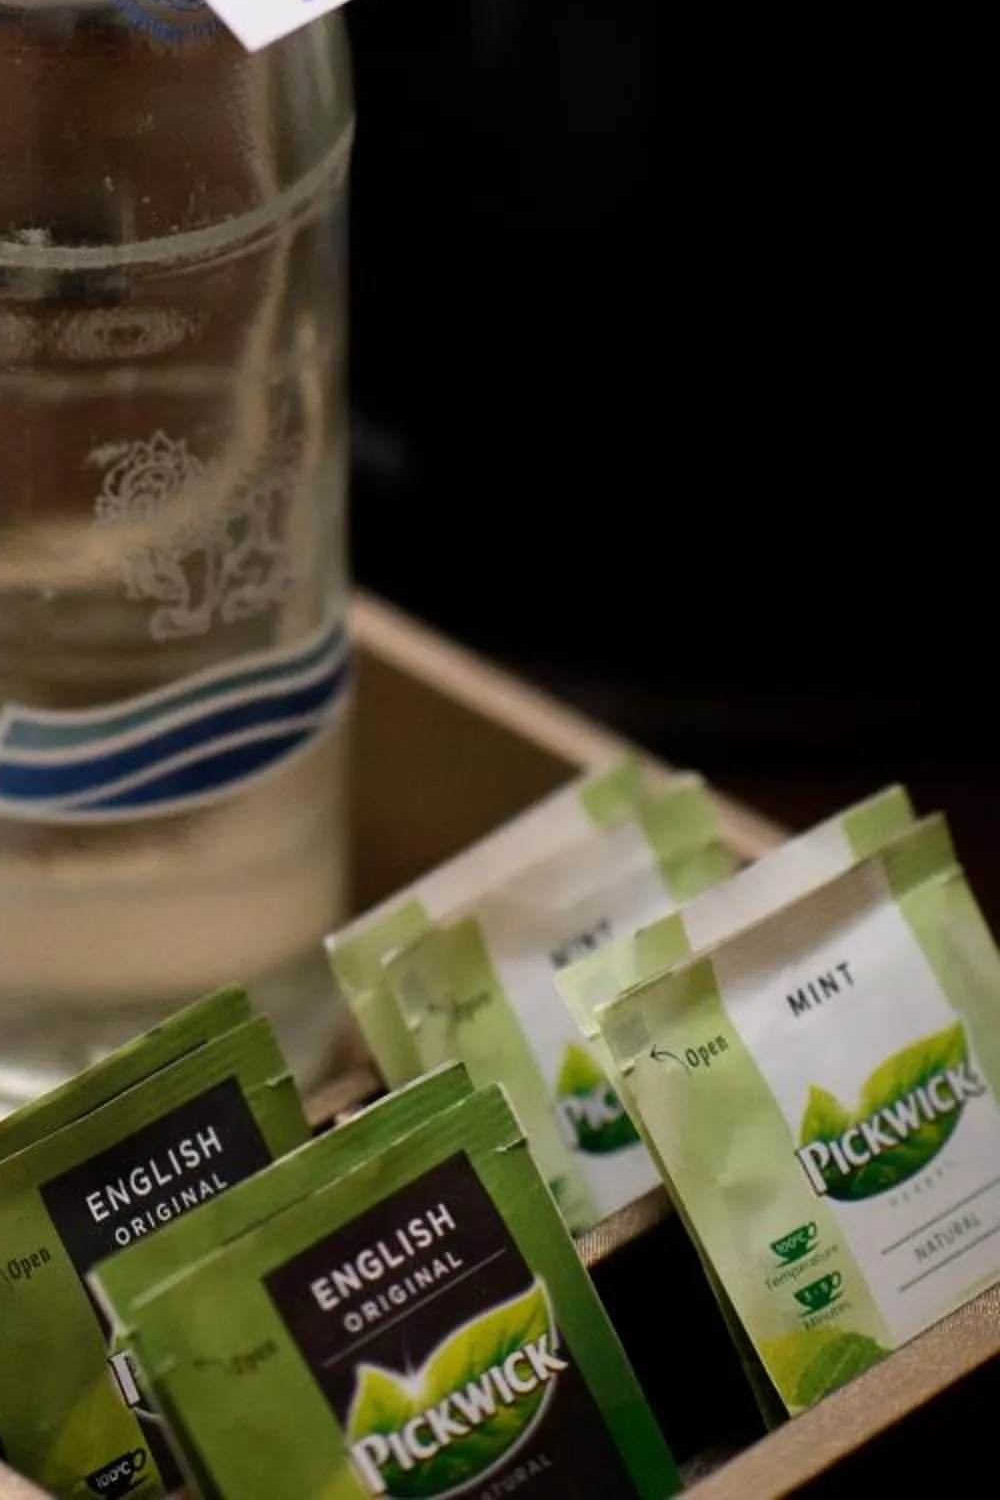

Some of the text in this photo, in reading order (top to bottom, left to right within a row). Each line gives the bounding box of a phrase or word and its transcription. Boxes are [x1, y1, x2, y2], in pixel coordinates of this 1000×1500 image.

[786, 961, 856, 1018] MINT
[686, 1032, 729, 1071] Open
[797, 1062, 987, 1197] PICKWICK
[86, 1125, 224, 1224] ENGLISH
[114, 1172, 229, 1247] ORIGINAL
[6, 1248, 52, 1281] Open
[310, 1203, 457, 1311] ENGLISH
[343, 1251, 464, 1334] ORIGINAL
[351, 1334, 568, 1495] PICKWICK
